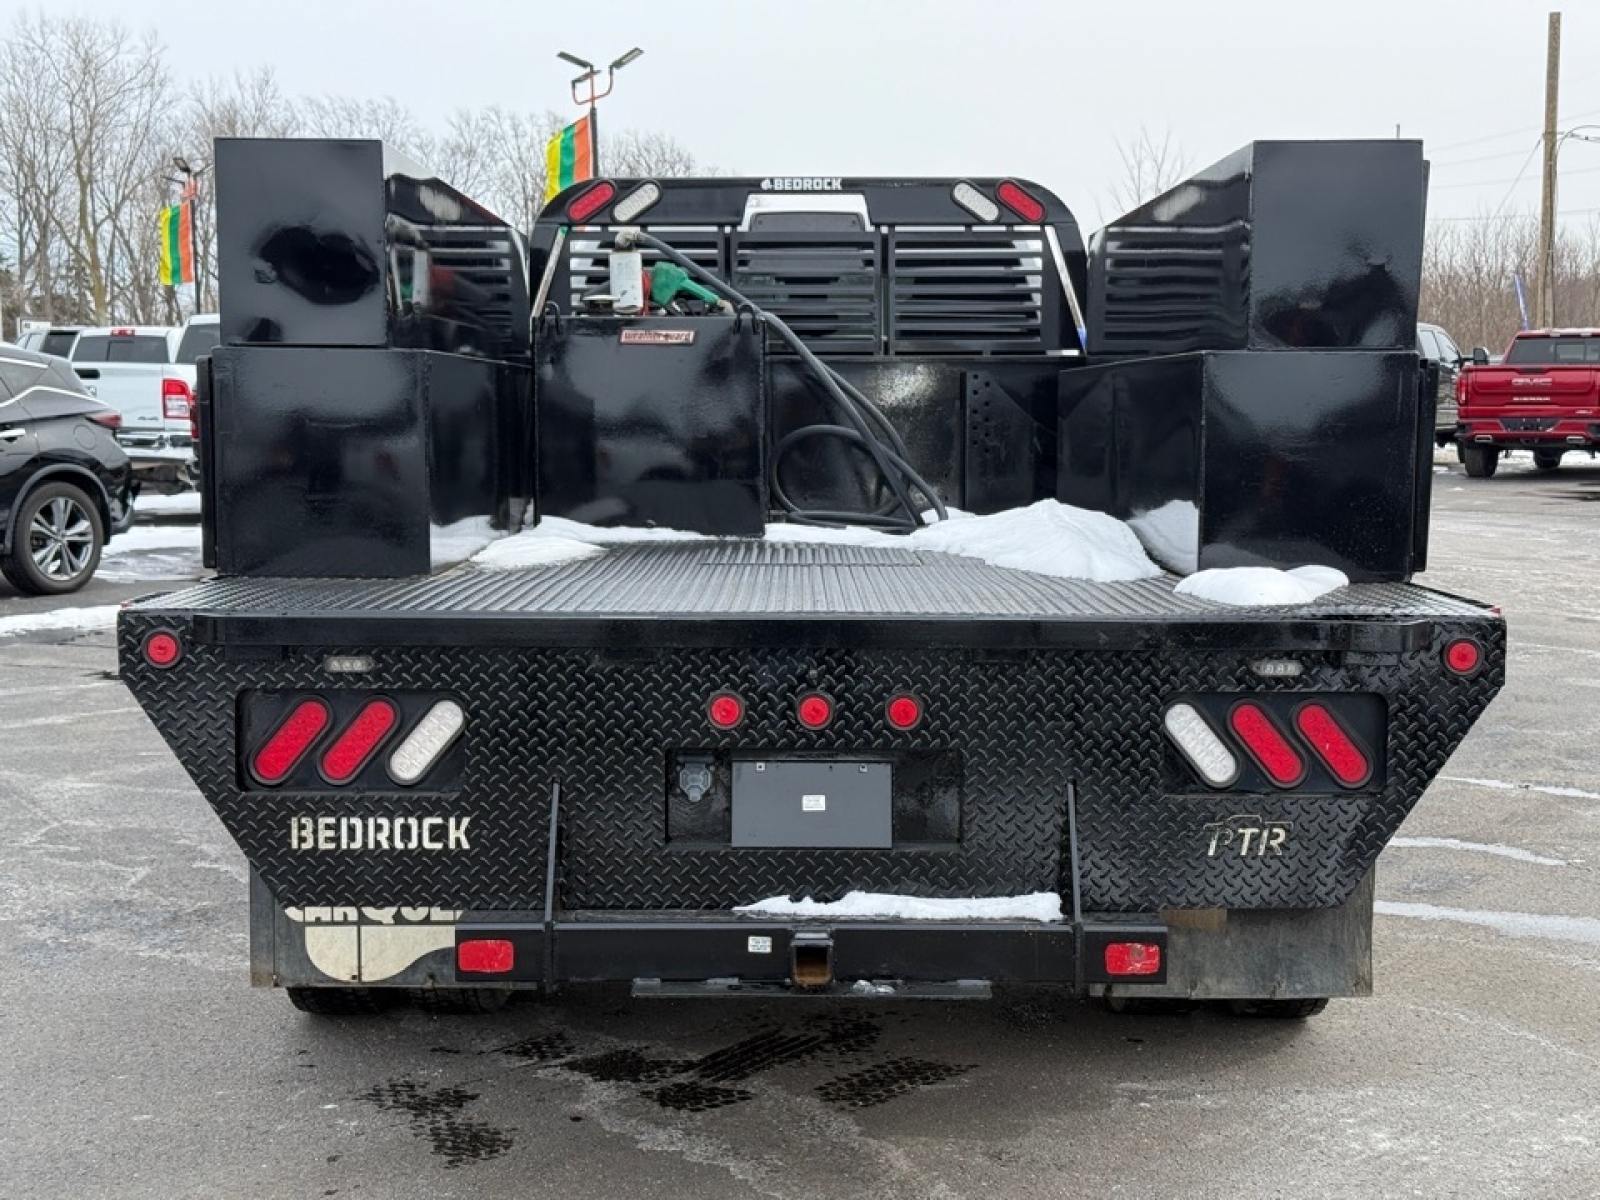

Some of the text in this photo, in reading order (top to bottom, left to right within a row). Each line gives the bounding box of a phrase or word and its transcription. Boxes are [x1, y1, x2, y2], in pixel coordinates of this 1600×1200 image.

[774, 178, 842, 190] BEDROCK
[291, 817, 471, 849] BEDROCK
[1208, 827, 1286, 856] PTR
